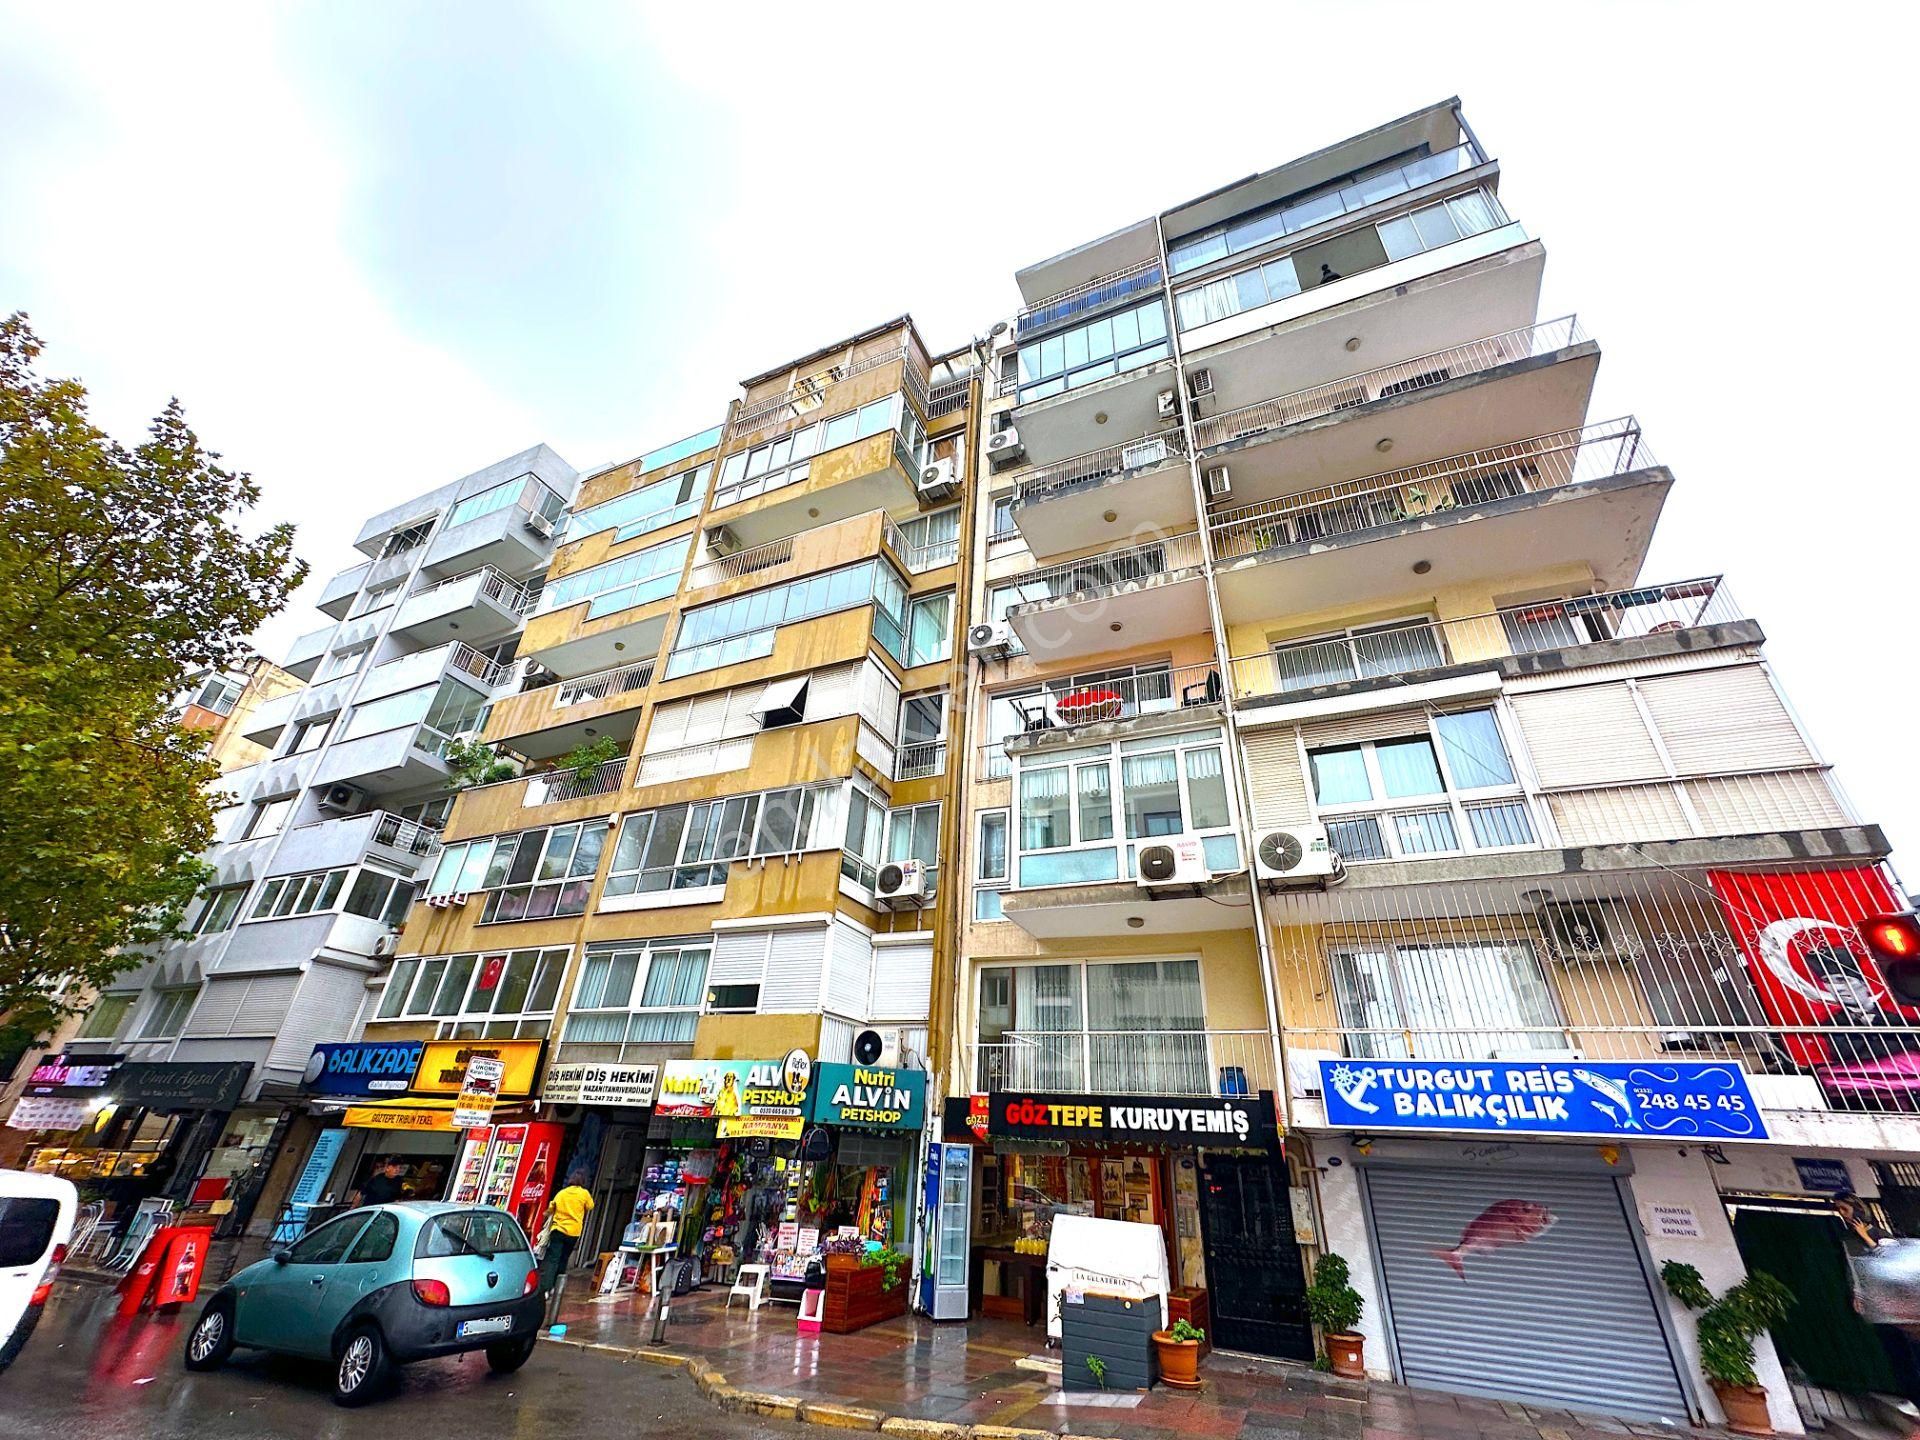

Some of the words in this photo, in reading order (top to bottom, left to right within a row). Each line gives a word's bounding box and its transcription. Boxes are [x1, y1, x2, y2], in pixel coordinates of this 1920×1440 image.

[327, 1048, 422, 1074] BALIKZADE
[548, 1068, 560, 1084] DİŞ
[560, 1067, 585, 1081] HEKİMİ
[586, 1068, 607, 1084] DİŞ
[610, 1069, 655, 1084] HEKİMİ
[744, 1064, 783, 1087] ALV
[854, 1068, 895, 1087] Nutri
[1378, 1068, 1493, 1092] TURGUT
[1508, 1064, 1575, 1093] REİS
[662, 1075, 700, 1095] Nutri
[742, 1089, 807, 1106] PETSHOP
[1636, 1093, 1680, 1110] 248
[1684, 1094, 1712, 1110] 45
[1717, 1094, 1746, 1111] 45
[841, 1107, 902, 1123] PETSHOP
[1394, 1091, 1570, 1126] BALIKÇILIK
[965, 1113, 989, 1126] GÖZT
[1005, 1098, 1104, 1128] GÖZTEPE
[1110, 1102, 1250, 1142] KURUYEMİŞ
[1654, 1207, 1692, 1215] PAZARTESİ
[1661, 1217, 1692, 1226] GÜNLERİ
[1076, 1273, 1085, 1281] LA
[1086, 1275, 1127, 1287] GELATERIA
